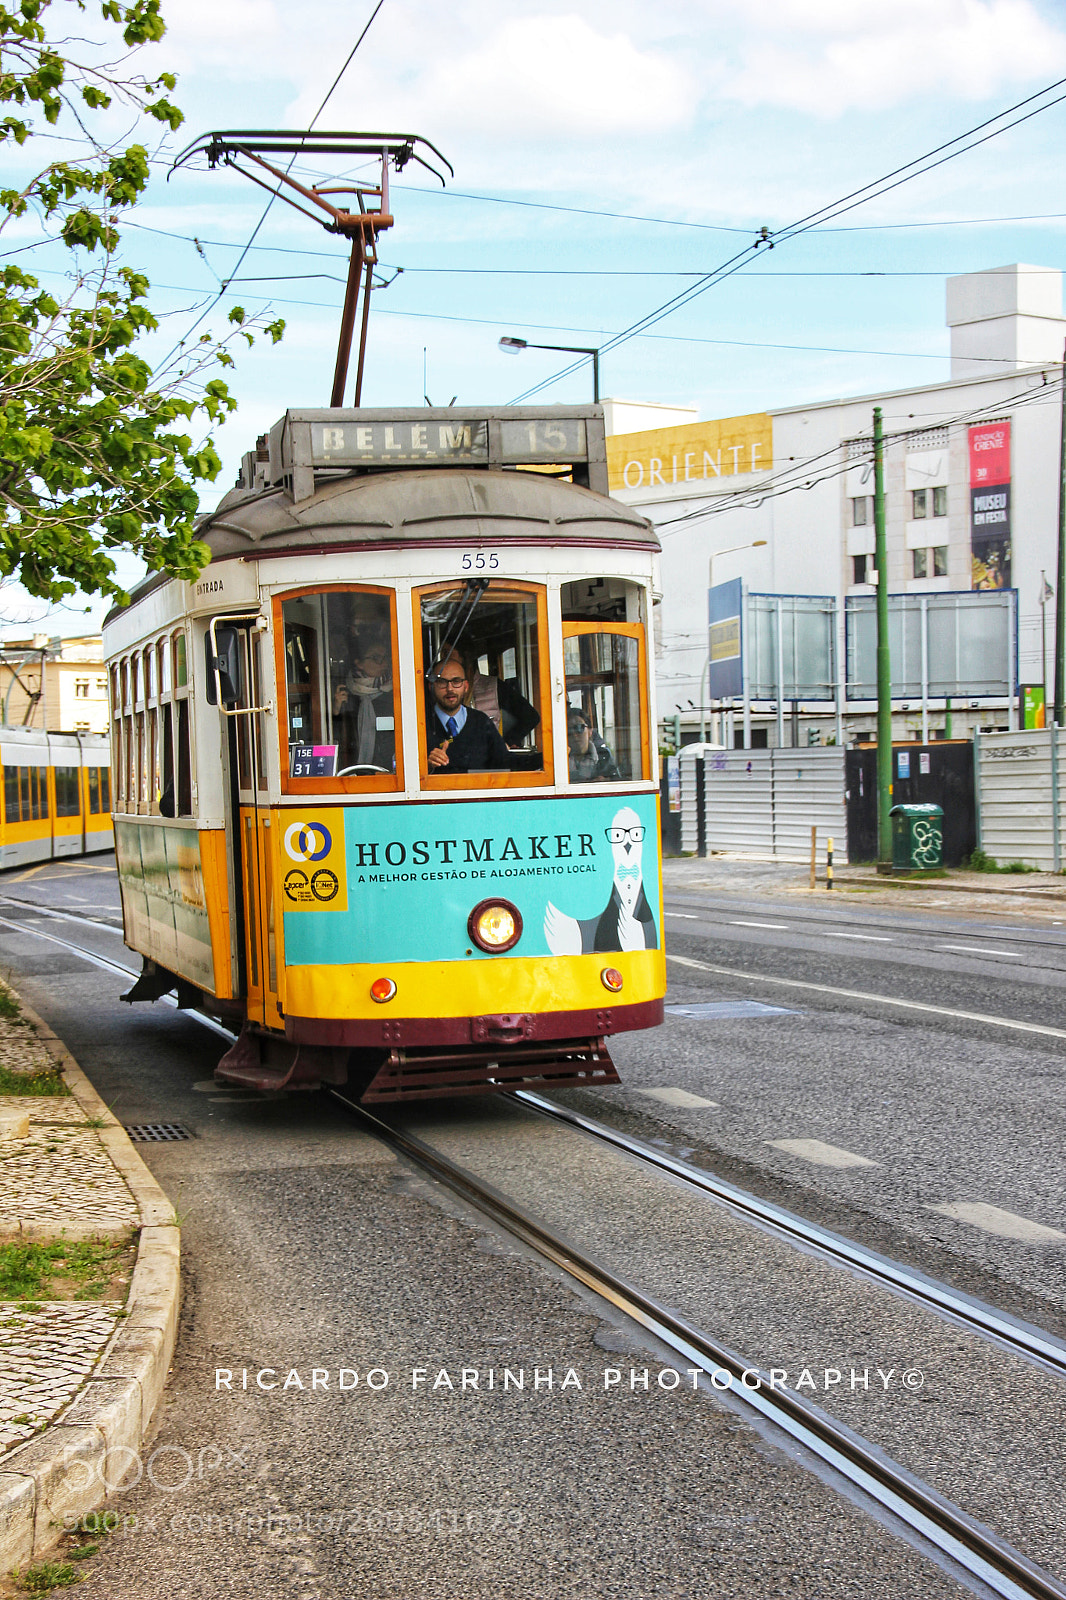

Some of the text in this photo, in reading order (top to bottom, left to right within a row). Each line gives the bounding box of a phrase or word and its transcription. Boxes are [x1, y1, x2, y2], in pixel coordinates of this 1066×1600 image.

[322, 423, 472, 451] BELÉM
[623, 443, 763, 489] ORIENTE
[973, 493, 1007, 512] MUSEU
[461, 552, 500, 570] 555
[196, 580, 224, 596] ENTRADA
[297, 749, 312, 757] 15E
[294, 763, 311, 775] 31
[355, 833, 597, 867] HOSTMAKER
[358, 864, 597, 883] A MELHOR GESTÃO DE ALOJAMENTO LOCAL
